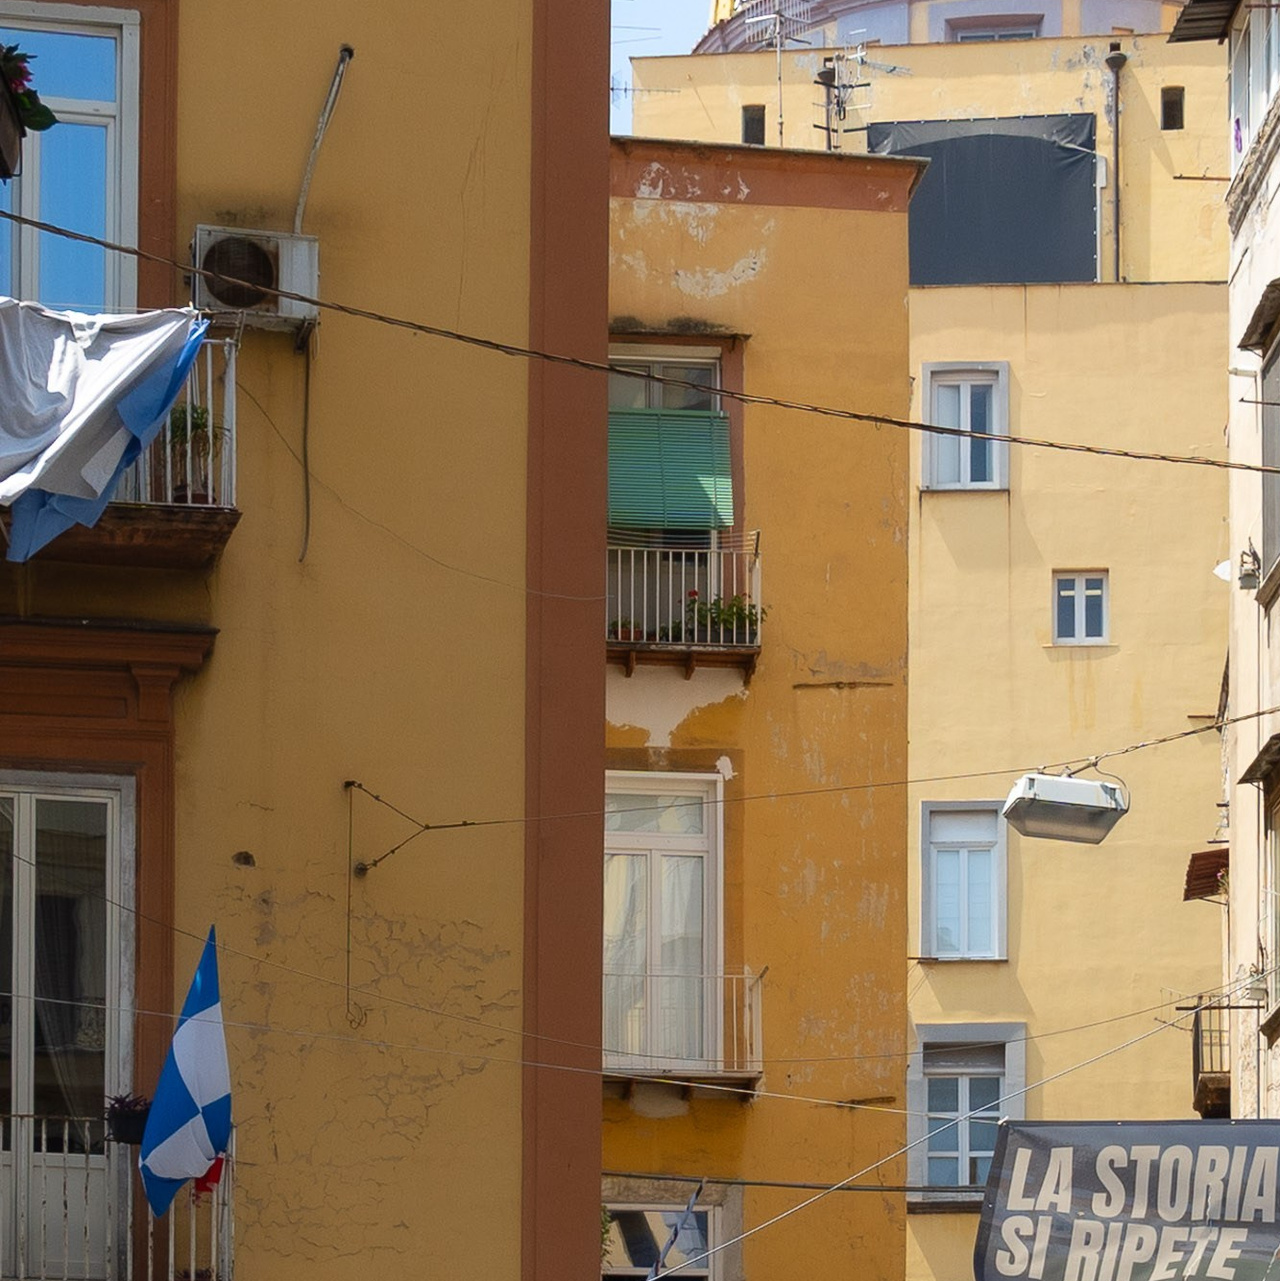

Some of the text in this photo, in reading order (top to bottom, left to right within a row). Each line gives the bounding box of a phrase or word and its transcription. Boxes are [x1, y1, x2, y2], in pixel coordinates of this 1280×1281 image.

[1006, 1144, 1280, 1223] LA STORIA
[995, 1214, 1058, 1280] SI
